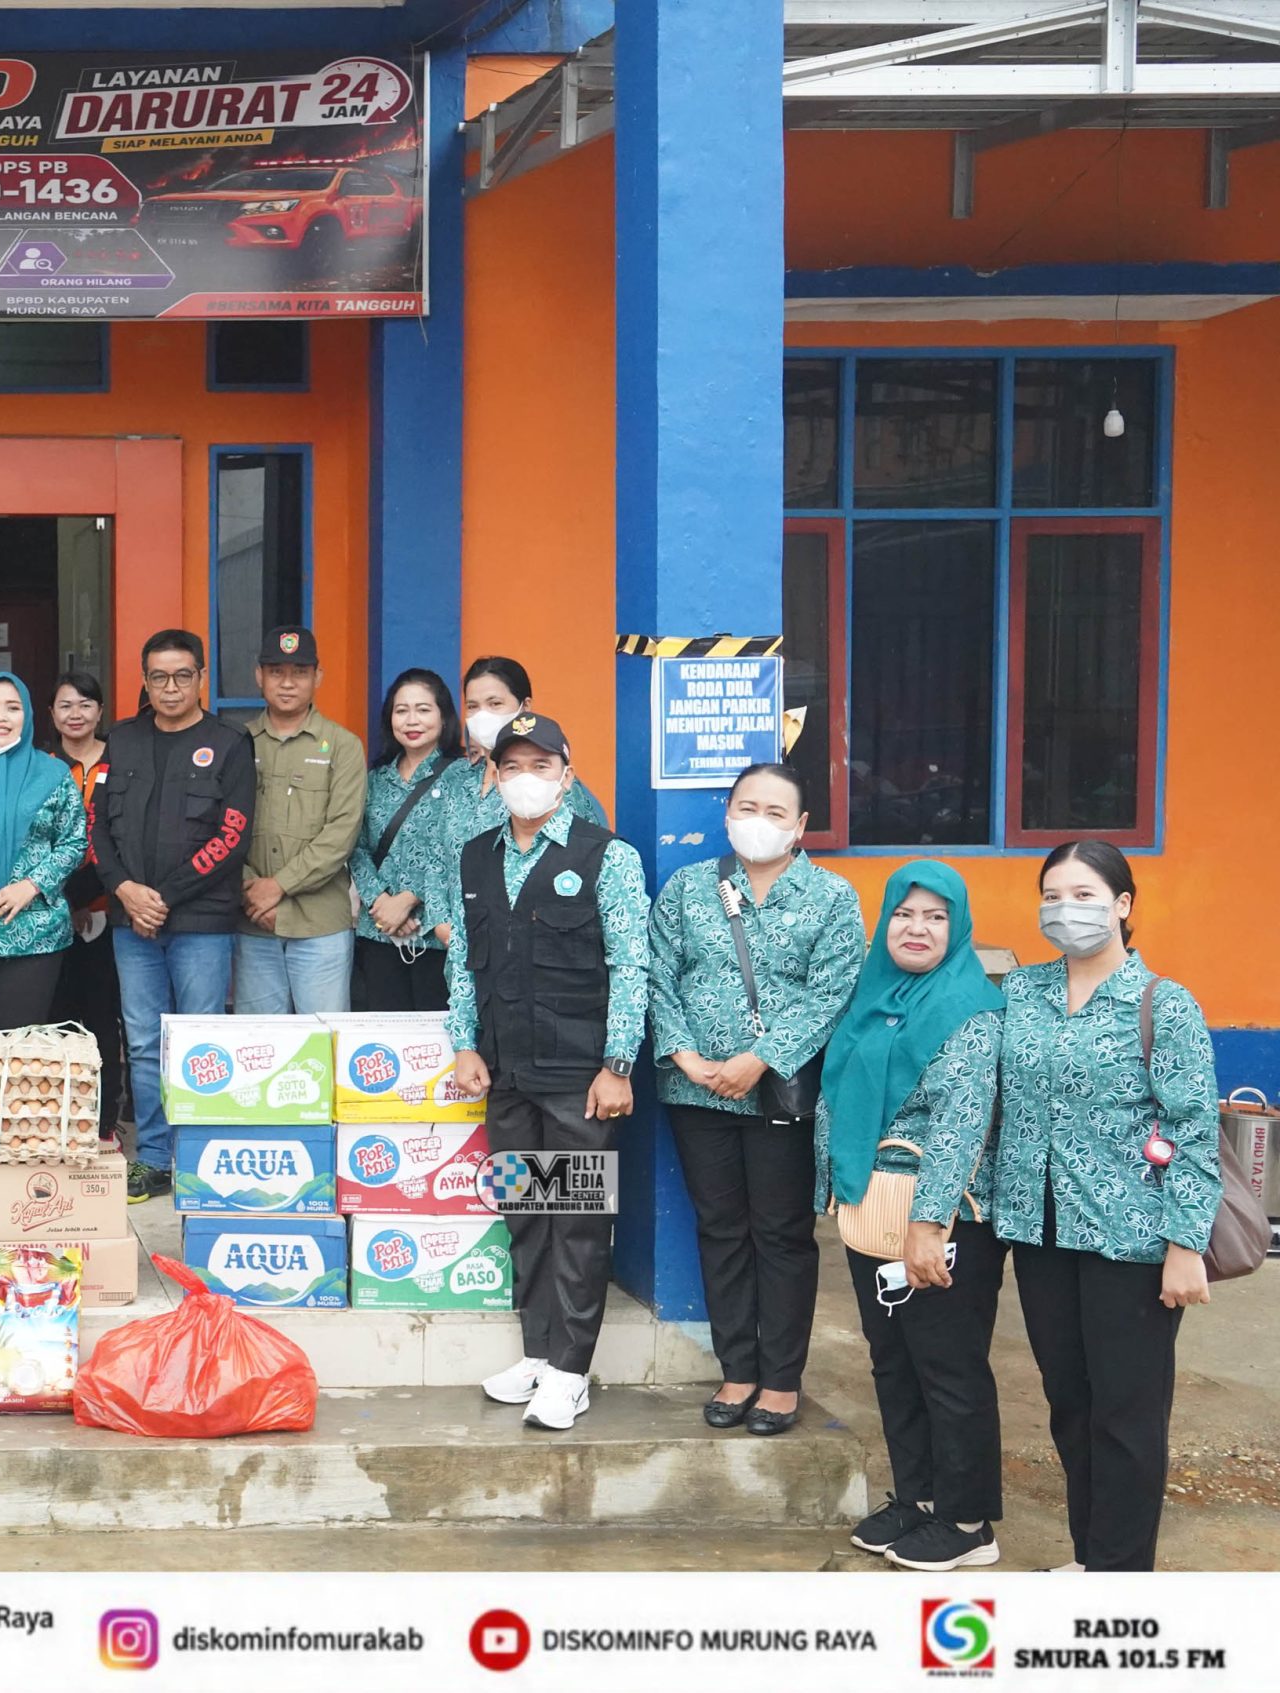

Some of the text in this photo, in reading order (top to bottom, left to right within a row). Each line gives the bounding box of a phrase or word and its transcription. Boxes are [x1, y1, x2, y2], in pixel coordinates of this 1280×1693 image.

[92, 66, 222, 89] LAYANAN
[318, 73, 380, 106] 24
[64, 83, 312, 135] DARURAT
[321, 105, 368, 119] JAM
[112, 134, 264, 149] SIAP MELAYANI ANDA
[39, 161, 68, 175] PB
[54, 211, 118, 221] BENCANA
[40, 278, 133, 287] ORANG HILANG
[6, 296, 130, 304] BPBD KABUPATEN
[295, 300, 330, 312] KITA
[335, 299, 416, 311] TANGGUH
[6, 306, 108, 315] MURUNG RAYA
[680, 663, 760, 680] KENDARAAN
[687, 680, 753, 697] RODA DUA
[669, 698, 771, 715] JANGAN PARKIR
[665, 715, 774, 734] MENUTUPI JALAN
[696, 734, 745, 751] MASUK
[689, 757, 725, 769] TERIMA
[192, 807, 248, 875] BPBD
[189, 1052, 218, 1075] POP
[355, 1051, 384, 1074] POP
[196, 1063, 229, 1086] MIE
[364, 1063, 396, 1086] MIE
[277, 1080, 306, 1091] SOTO
[277, 1091, 308, 1101] AYAM
[356, 1143, 385, 1166] POP
[1252, 1127, 1266, 1176] BPBD TA
[214, 1148, 298, 1181] AQUA
[364, 1155, 396, 1178] MIE
[374, 1238, 403, 1261] POP
[224, 1243, 308, 1275] AQUA
[381, 1249, 413, 1272] MIE
[457, 1271, 496, 1286] BASO
